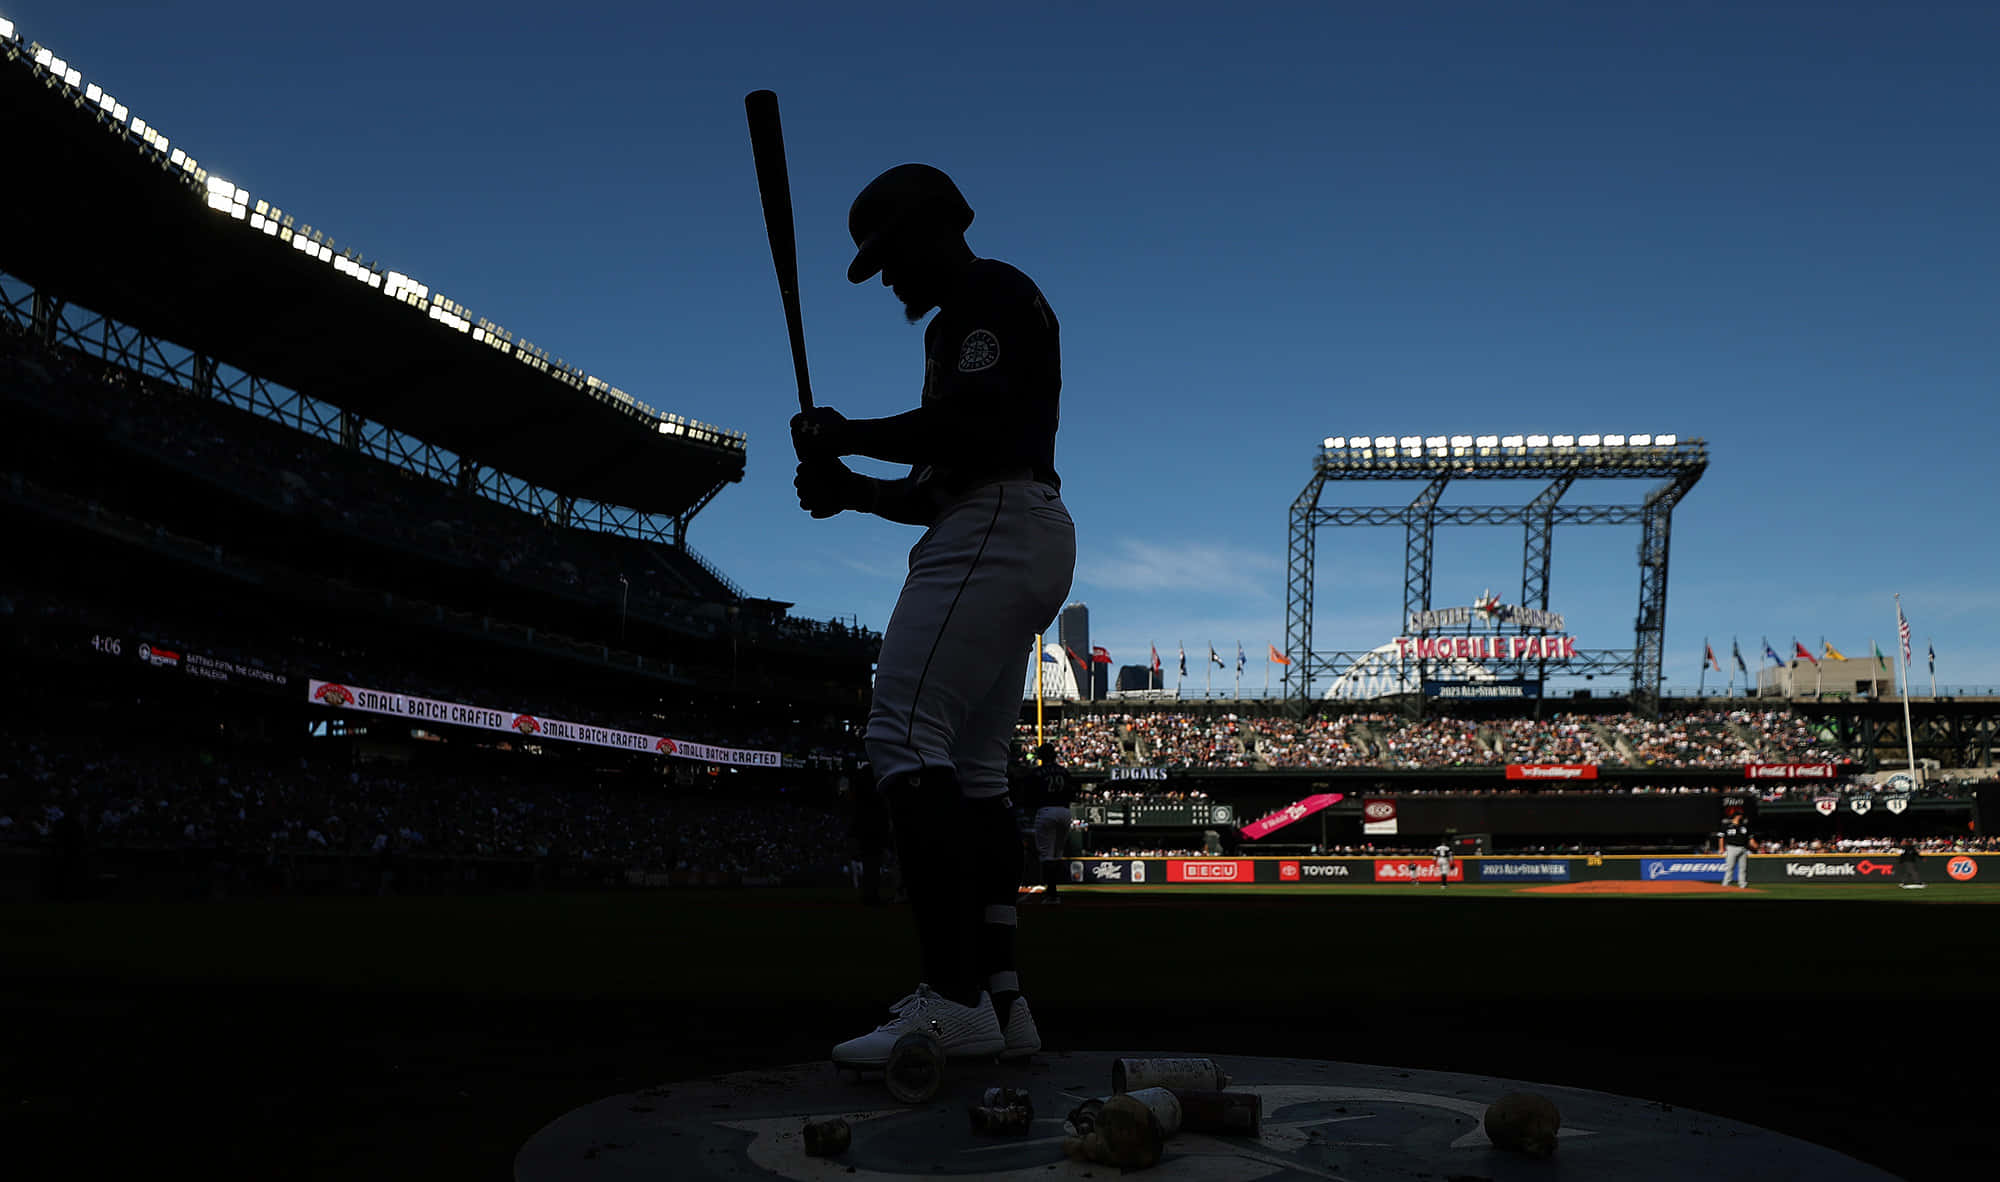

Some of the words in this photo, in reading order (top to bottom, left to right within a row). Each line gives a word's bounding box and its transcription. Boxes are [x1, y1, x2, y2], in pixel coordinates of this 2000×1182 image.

[90, 633, 121, 656] 4:06
[1511, 636, 1577, 660] PARK
[1440, 685, 1460, 697] 2023
[1499, 685, 1524, 697] WEEK
[358, 691, 403, 713] SMALL
[408, 701, 447, 720] BATCH
[452, 708, 502, 728] CRAFTED
[542, 721, 576, 739] SMALL
[579, 727, 608, 744] BATCH
[611, 731, 649, 749] CRAFTED
[678, 743, 704, 759] SMALL
[705, 747, 729, 761] BATCH
[732, 748, 777, 765] CRAFTED
[1188, 865, 1234, 876] BECU
[1301, 865, 1349, 877] TOYOTA
[1482, 863, 1504, 875] 2023
[1541, 863, 1566, 875] WEEK
[1669, 863, 1729, 873] BOEING
[1786, 861, 1856, 878] KeyBank
[1951, 862, 1971, 875] 76
